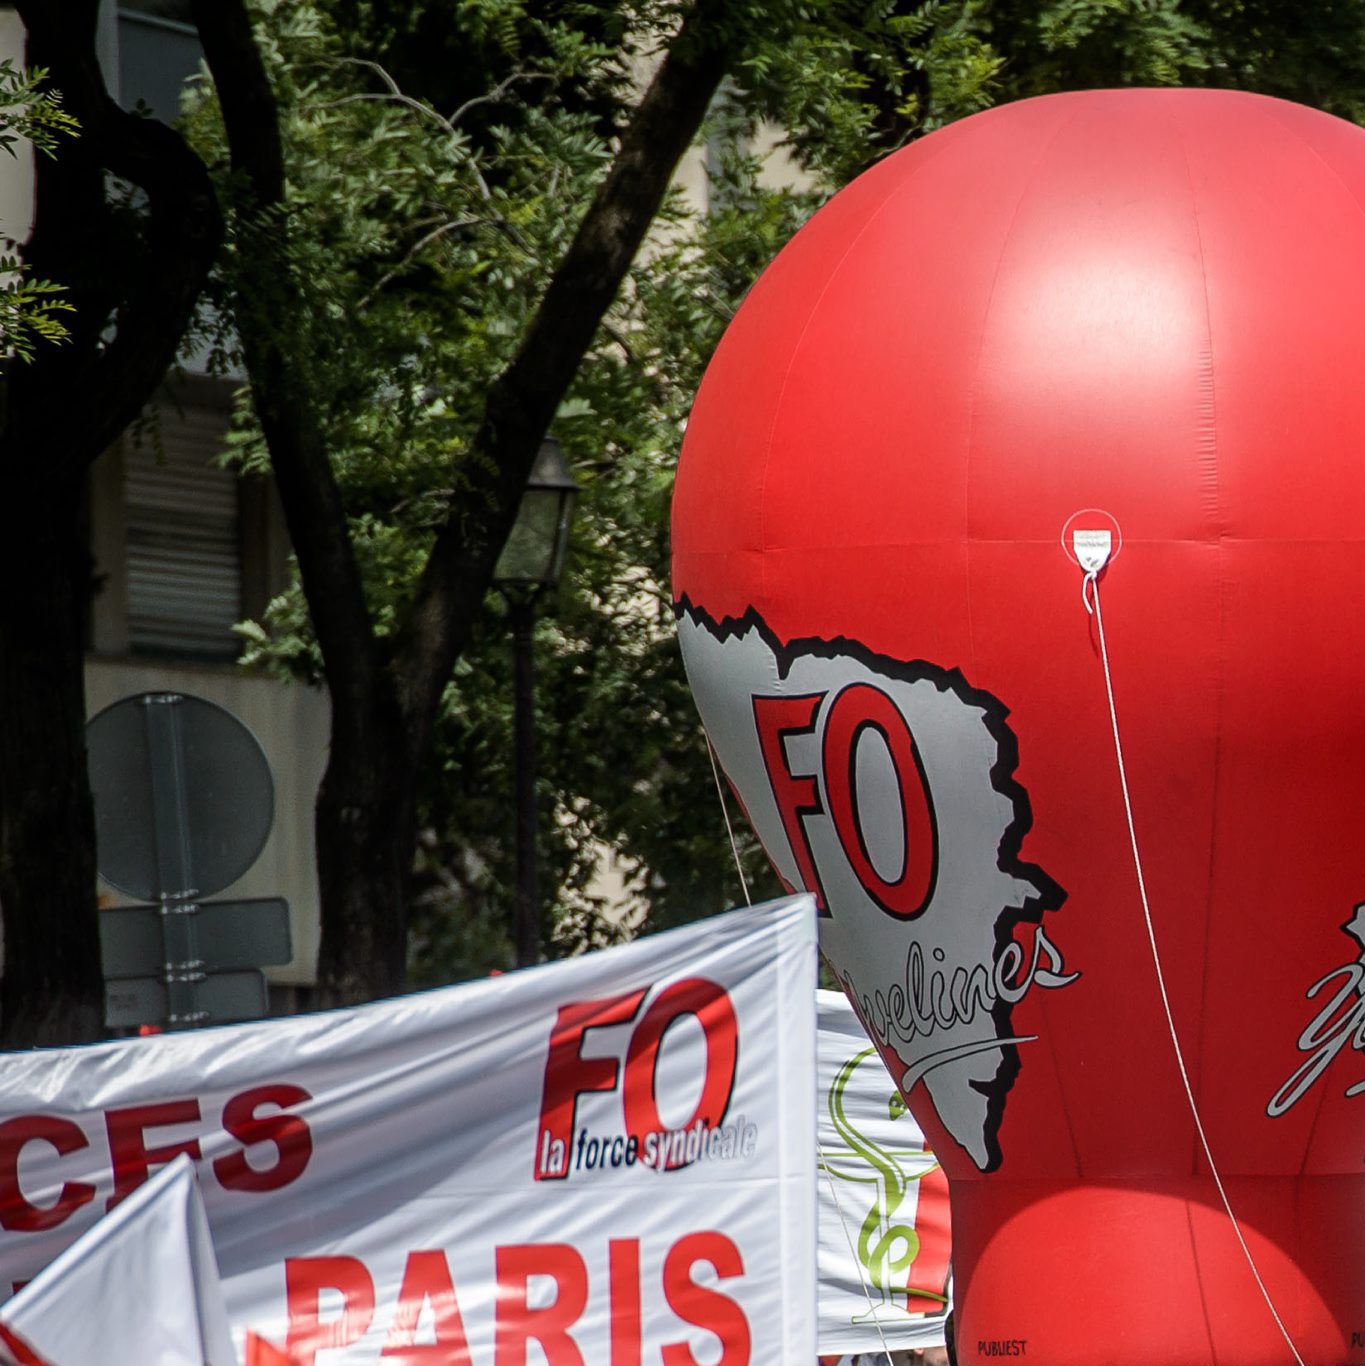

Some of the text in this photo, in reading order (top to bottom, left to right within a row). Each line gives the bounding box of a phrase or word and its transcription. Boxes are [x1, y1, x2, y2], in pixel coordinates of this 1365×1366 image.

[752, 681, 940, 922] FO
[534, 976, 740, 1181] FO
[538, 1114, 758, 1174] la force syndicale
[977, 1340, 1027, 1357] PUBLIEST
